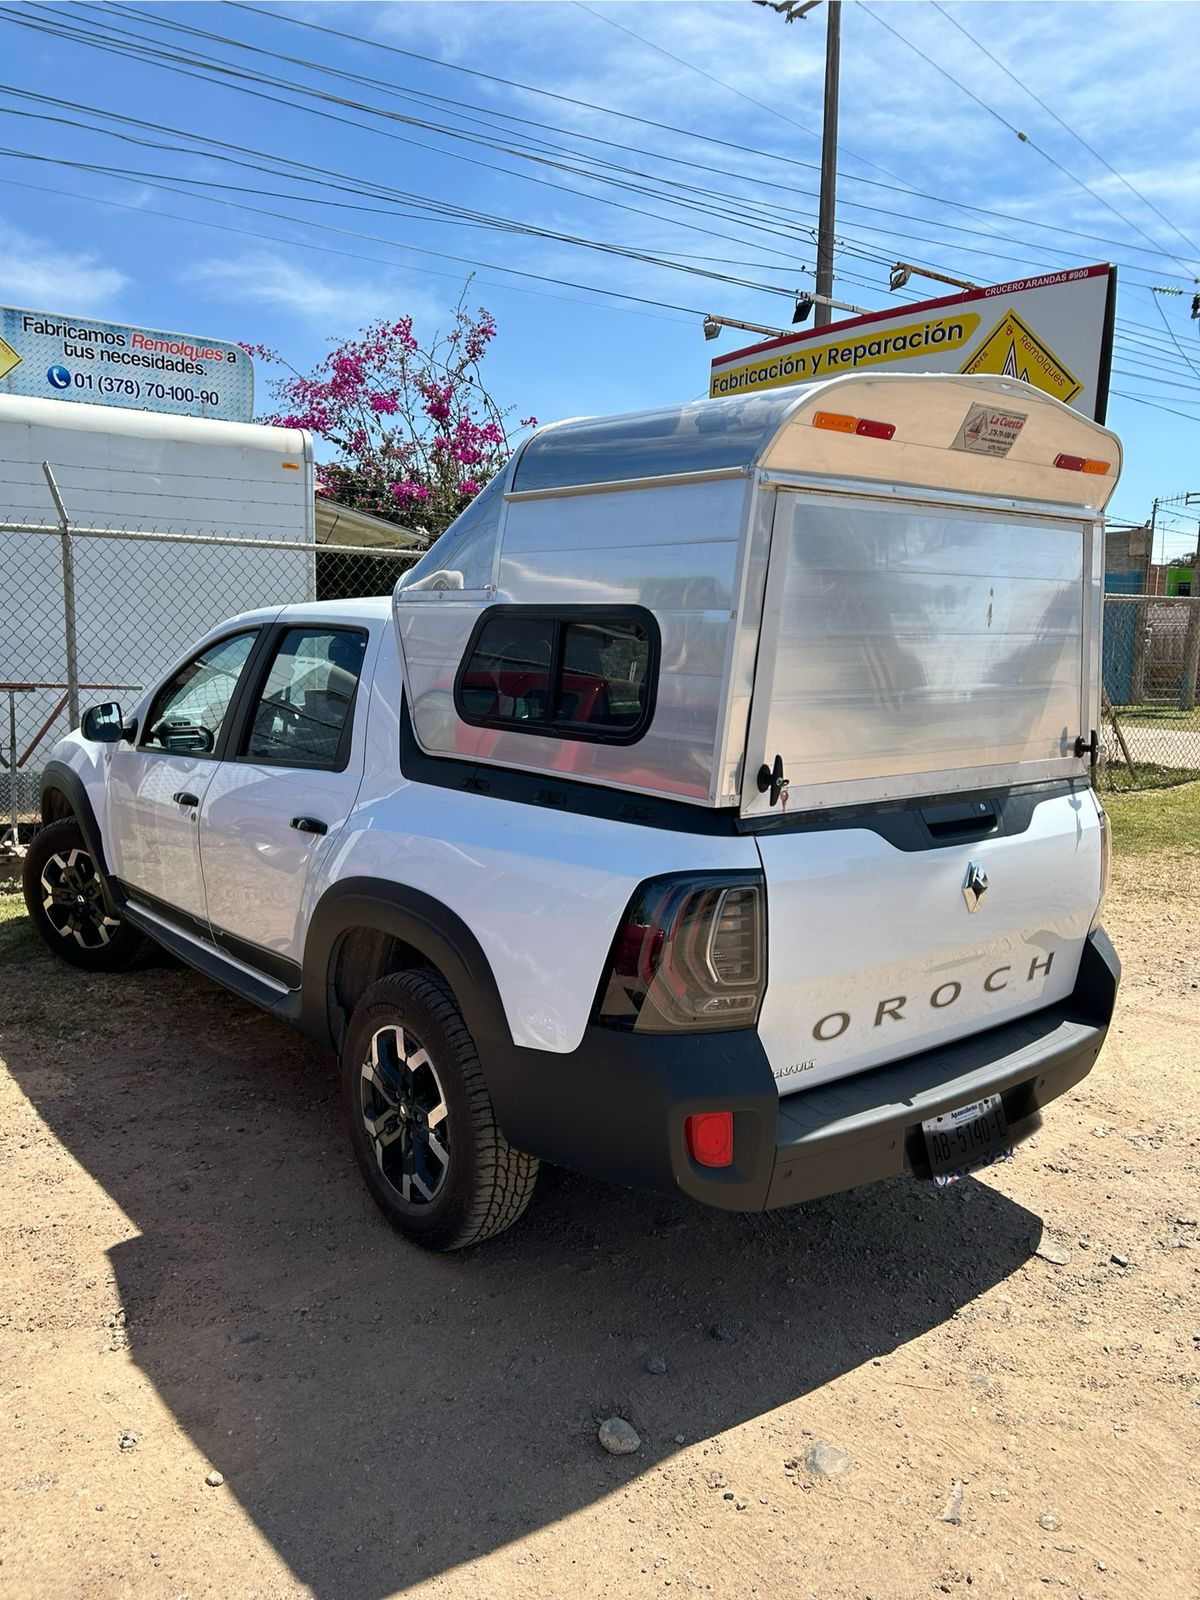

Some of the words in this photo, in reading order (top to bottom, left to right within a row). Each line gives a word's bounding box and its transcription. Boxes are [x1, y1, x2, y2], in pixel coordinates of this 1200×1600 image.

[985, 281, 1025, 296] CRUCERO
[1026, 273, 1067, 288] ARANDAS
[1069, 268, 1089, 280] #900
[22, 315, 126, 347] Fabricamos
[131, 332, 224, 362] Remolques
[227, 351, 236, 364] a
[63, 341, 95, 360] tus
[100, 349, 208, 376] necesidades.
[712, 355, 806, 395] Fabricación
[811, 354, 823, 374] y
[827, 321, 963, 366] Reparación
[1019, 334, 1066, 387] Remolques
[74, 373, 93, 389] 01
[99, 376, 141, 399] (378)
[144, 383, 219, 406] 70-100-90
[989, 415, 999, 425] La
[1000, 416, 1023, 430] Cuesta
[811, 951, 1056, 1042] OROCH
[932, 1110, 1008, 1164] AB-5140-E
